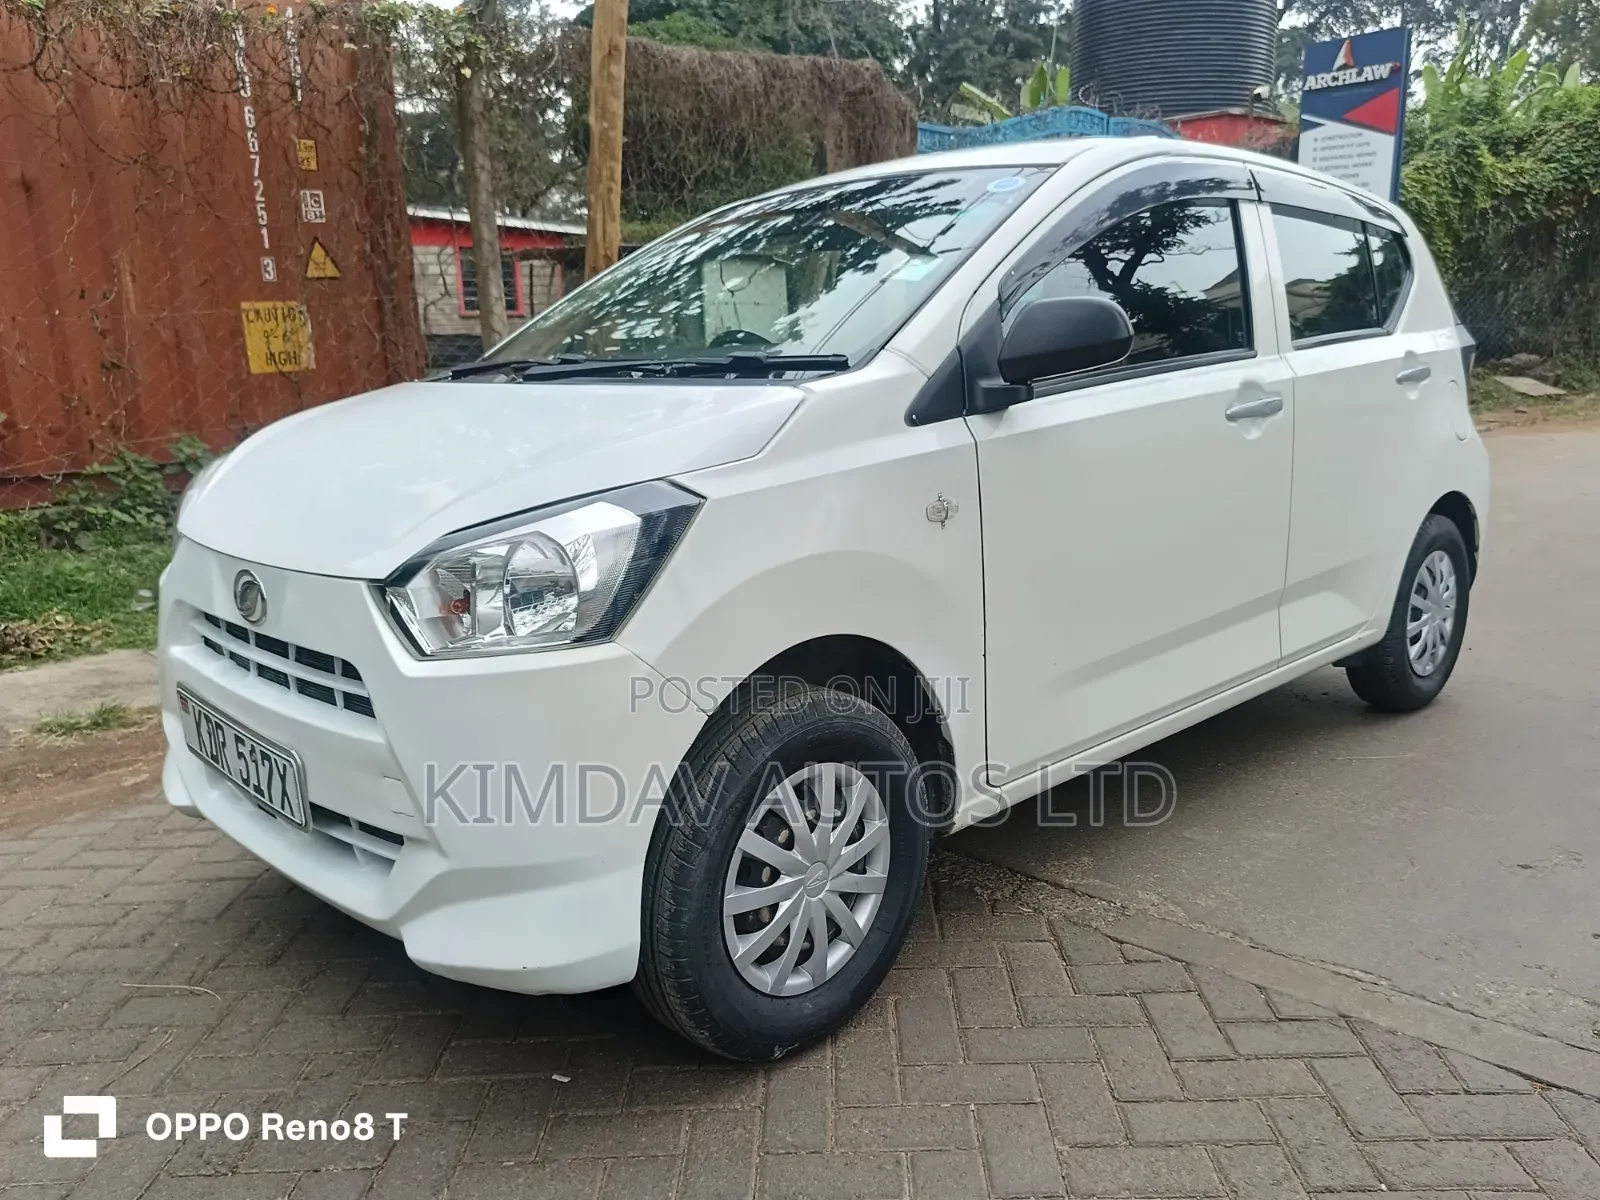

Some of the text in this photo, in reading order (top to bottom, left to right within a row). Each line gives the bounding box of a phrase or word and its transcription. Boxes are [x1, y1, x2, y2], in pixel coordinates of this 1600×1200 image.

[1303, 63, 1393, 91] ARCHLAW
[192, 705, 295, 818] KDR 517X
